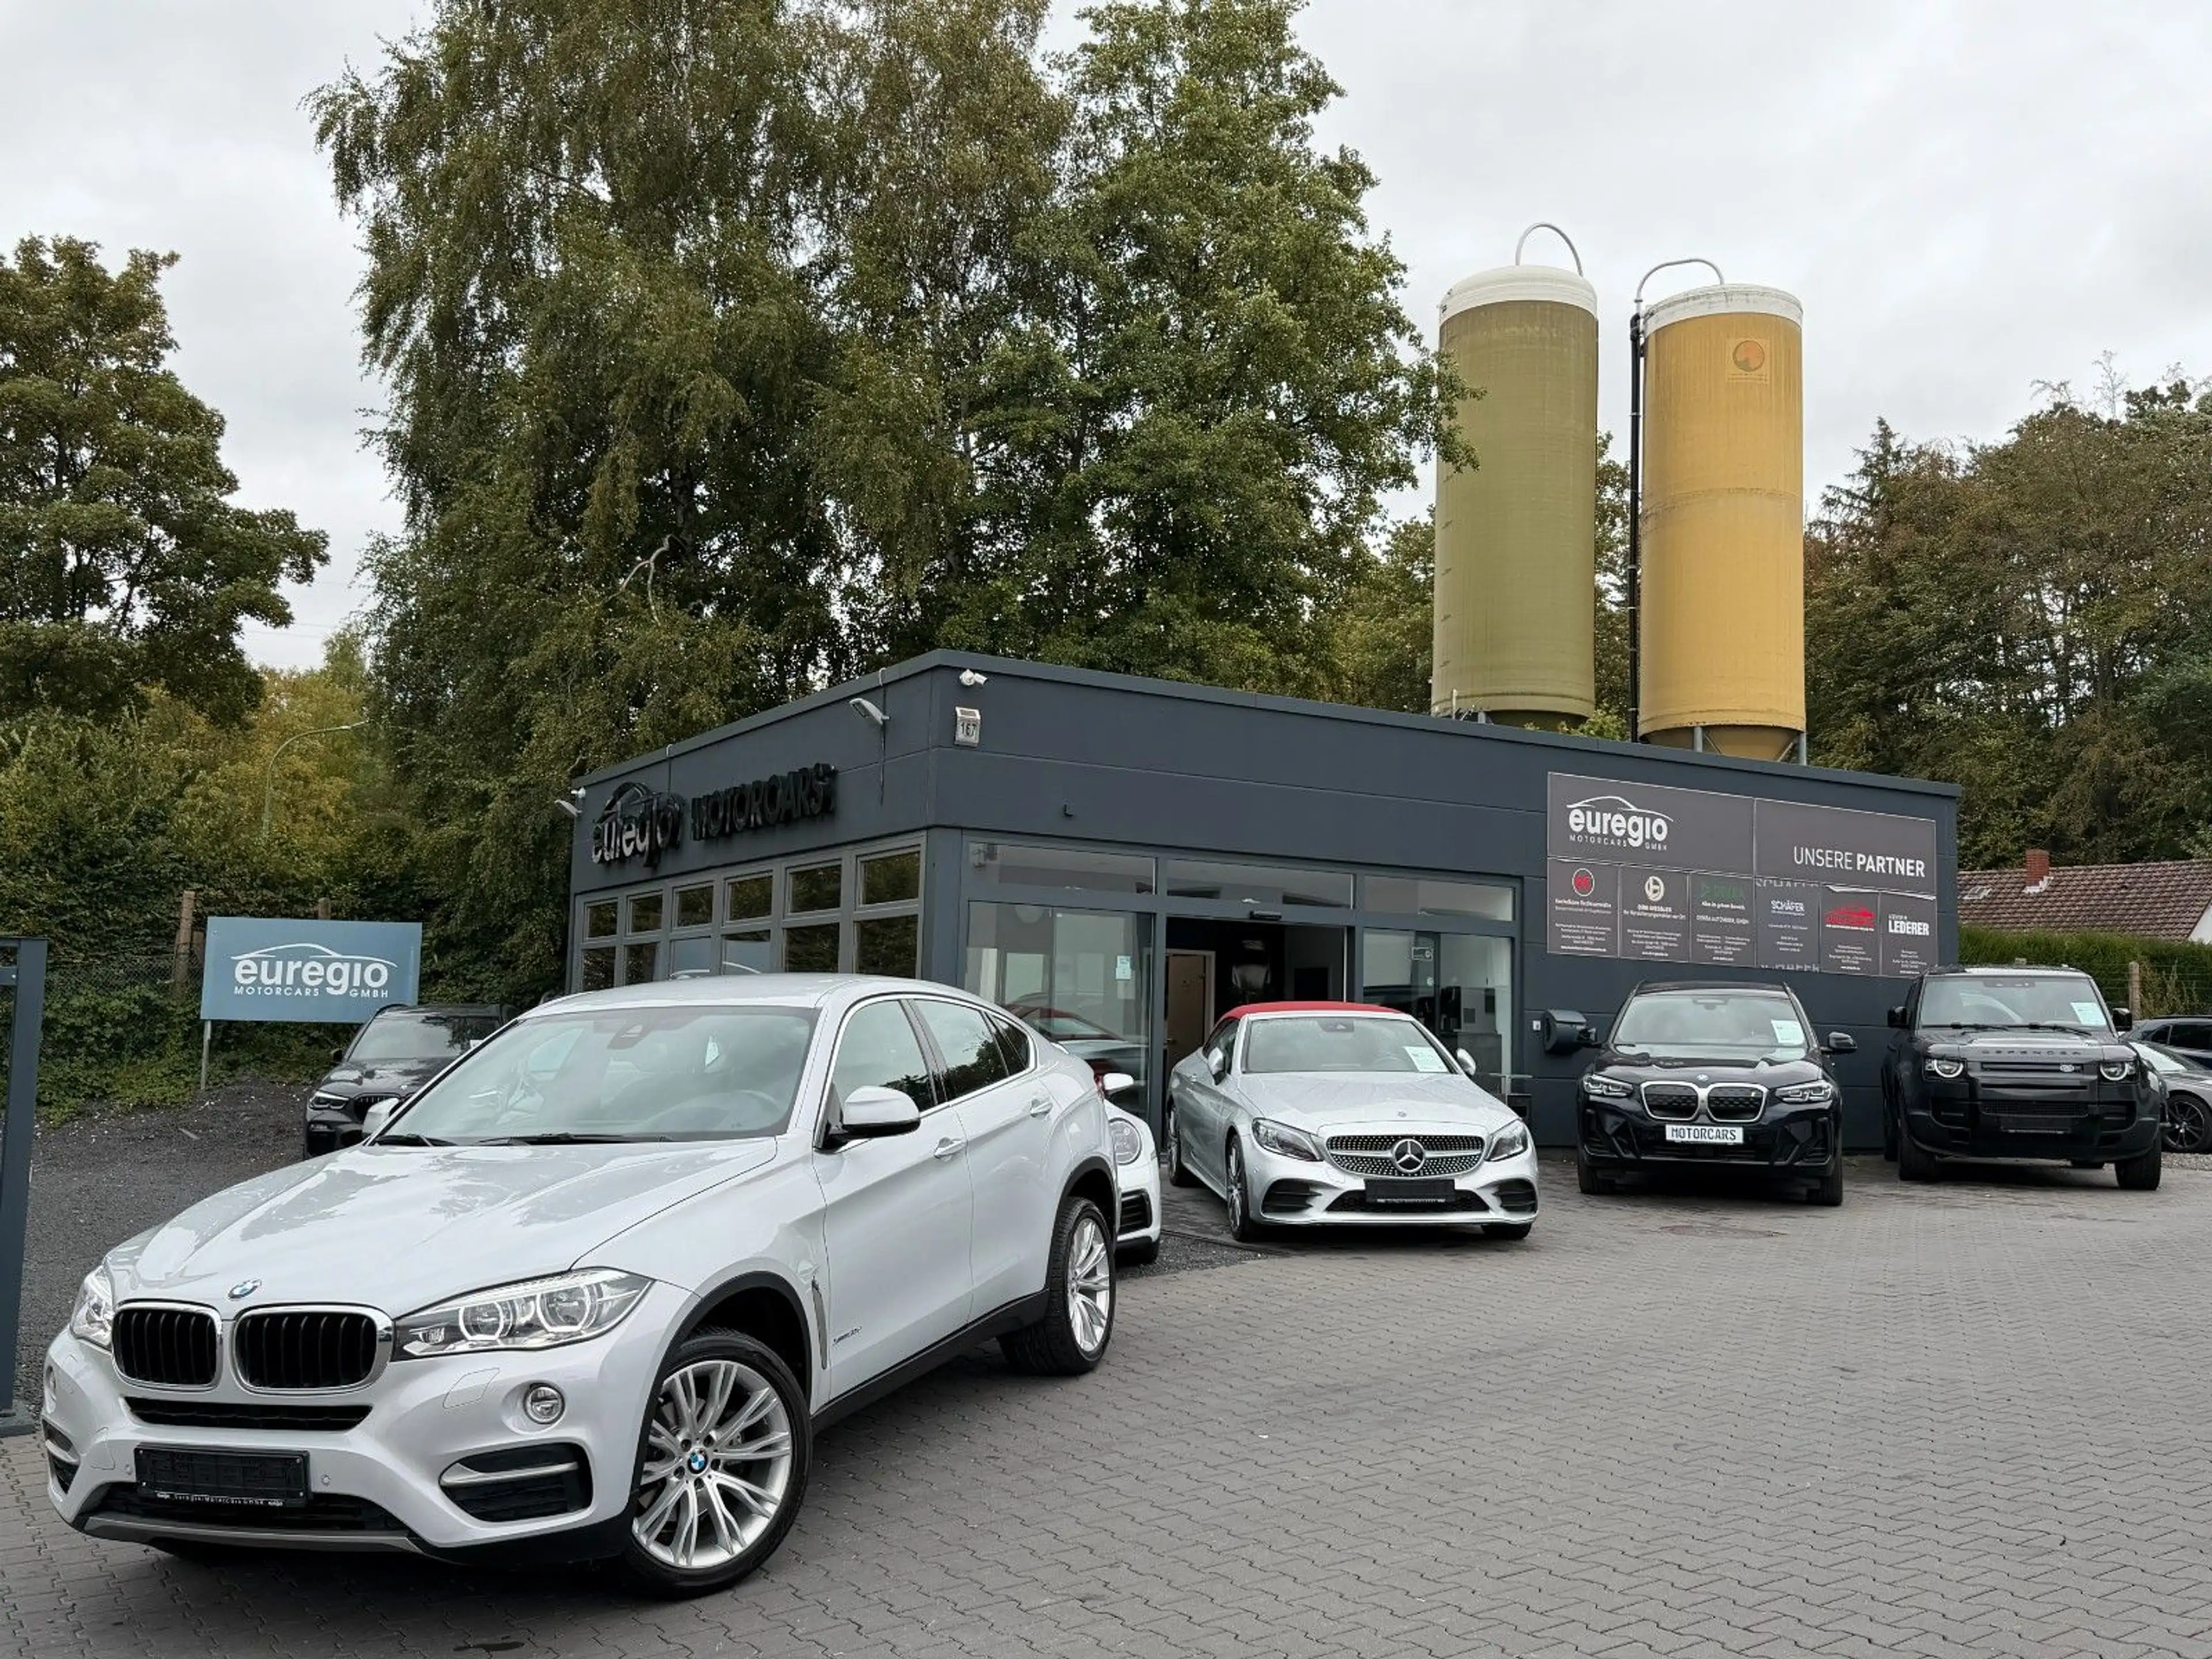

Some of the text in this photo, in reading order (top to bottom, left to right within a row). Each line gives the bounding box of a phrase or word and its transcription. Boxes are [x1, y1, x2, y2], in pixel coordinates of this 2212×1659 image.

[1569, 809, 1668, 847] euregio
[1569, 835, 1627, 847] MOTORCARS
[1794, 846, 1926, 878] UNSERE PARTNER
[1888, 919, 1930, 936] LEDERER
[234, 959, 389, 995] euregio
[233, 986, 388, 998] MOTORCARS GMBH
[1671, 1127, 1736, 1141] MOTORCARS
